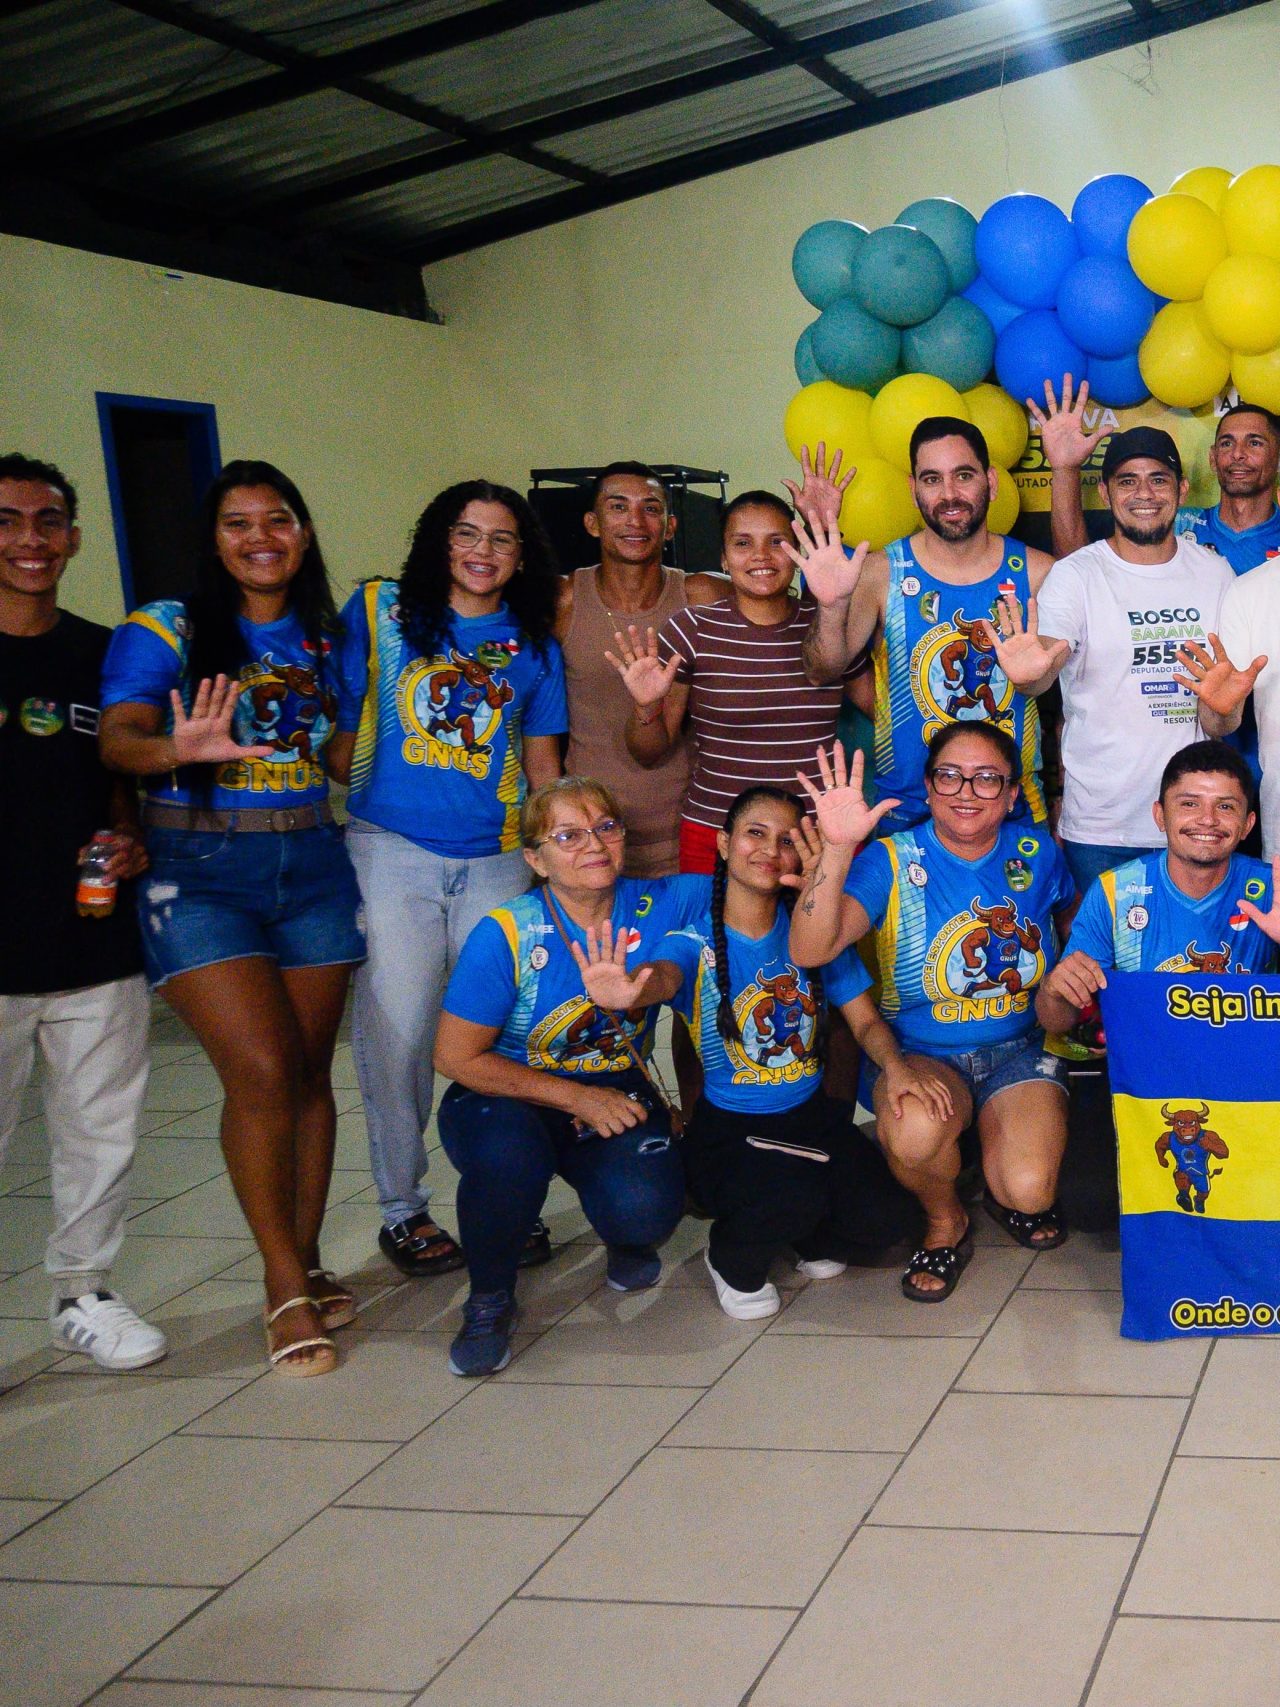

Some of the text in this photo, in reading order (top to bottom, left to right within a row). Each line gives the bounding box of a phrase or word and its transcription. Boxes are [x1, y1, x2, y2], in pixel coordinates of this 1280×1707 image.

[1127, 607, 1201, 625] BOSCO
[1131, 625, 1206, 641] SARAIVA
[1131, 666, 1172, 674] DEPUTADO
[1164, 716, 1199, 724] RESOLVE
[402, 736, 490, 779] GNUS
[927, 911, 972, 962] ESPORTES
[932, 991, 1029, 1022] GNUS
[1169, 987, 1244, 1025] Seja
[1173, 1299, 1248, 1327] Onde
[1253, 1304, 1273, 1325] o
